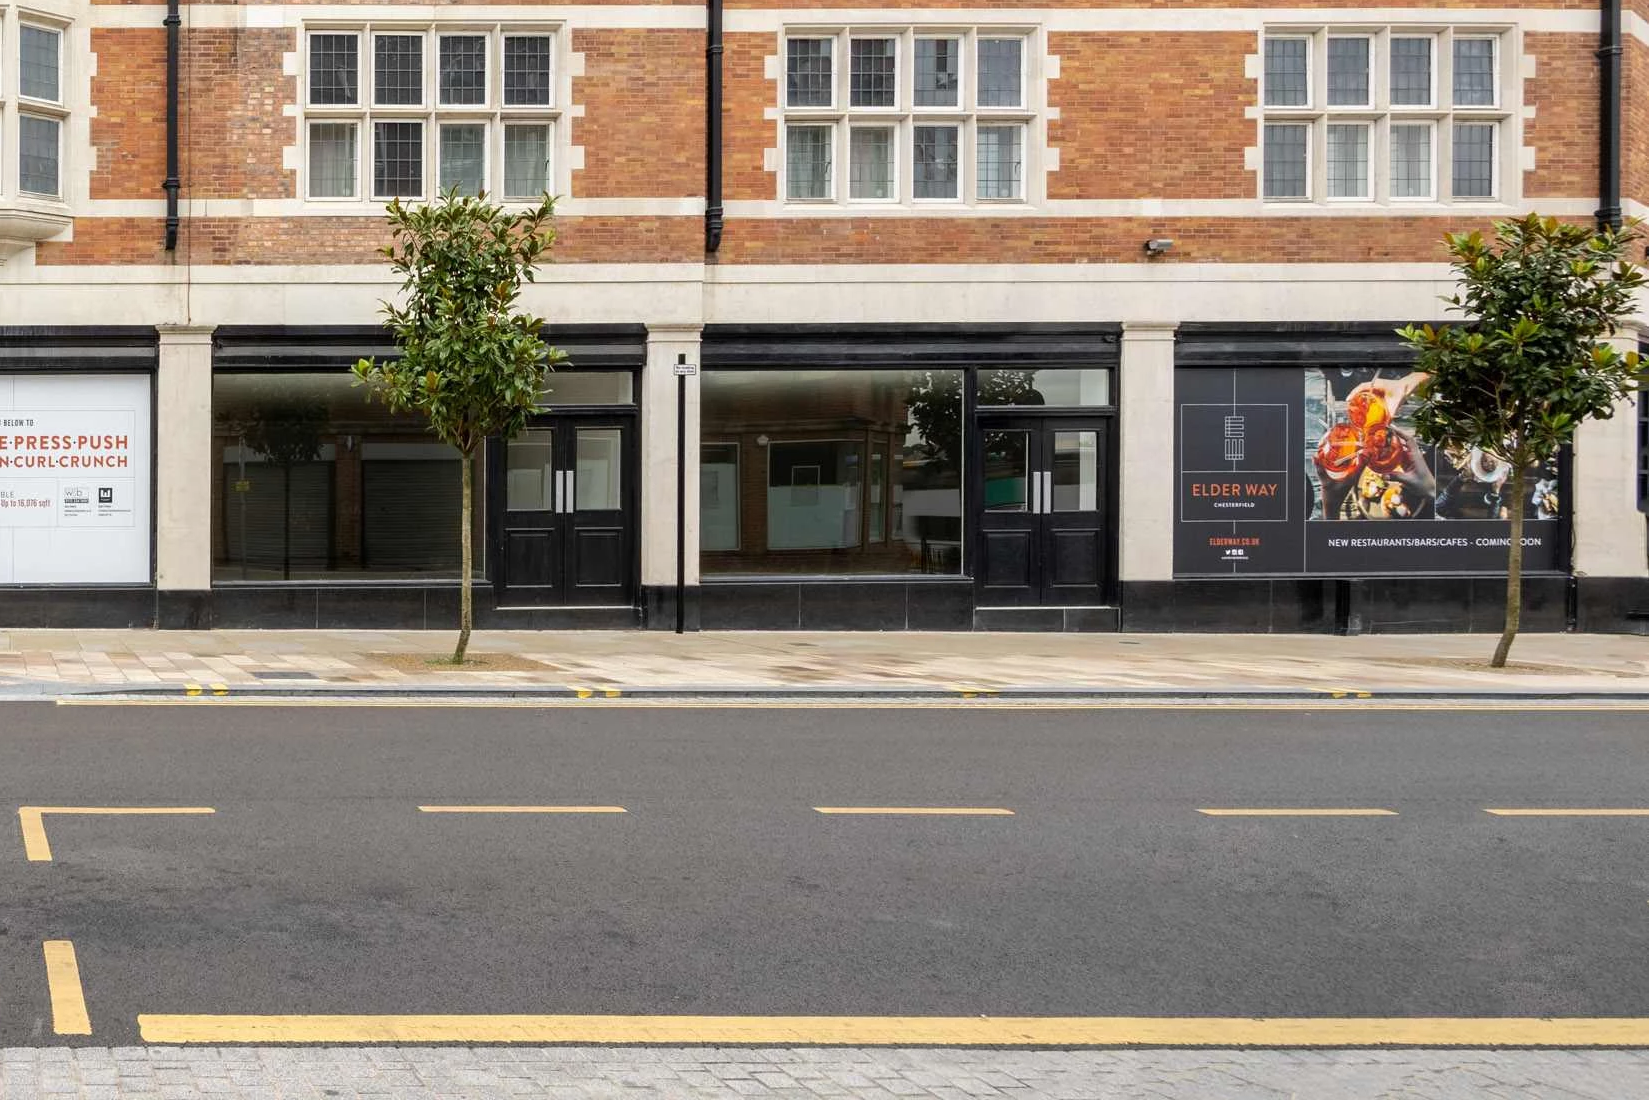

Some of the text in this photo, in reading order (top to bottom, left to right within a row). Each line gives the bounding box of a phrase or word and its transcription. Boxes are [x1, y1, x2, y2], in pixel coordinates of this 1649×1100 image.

[3, 419, 25, 427] BELOW
[26, 419, 35, 427] TO
[1192, 483, 1278, 497] ELDER WAY
[0, 499, 9, 508] Up
[1209, 537, 1261, 546] ELDERWAY.CO.UK
[1328, 538, 1349, 548] NEW
[1351, 537, 1468, 547] RESTAURANTS/BARS/CAFES
